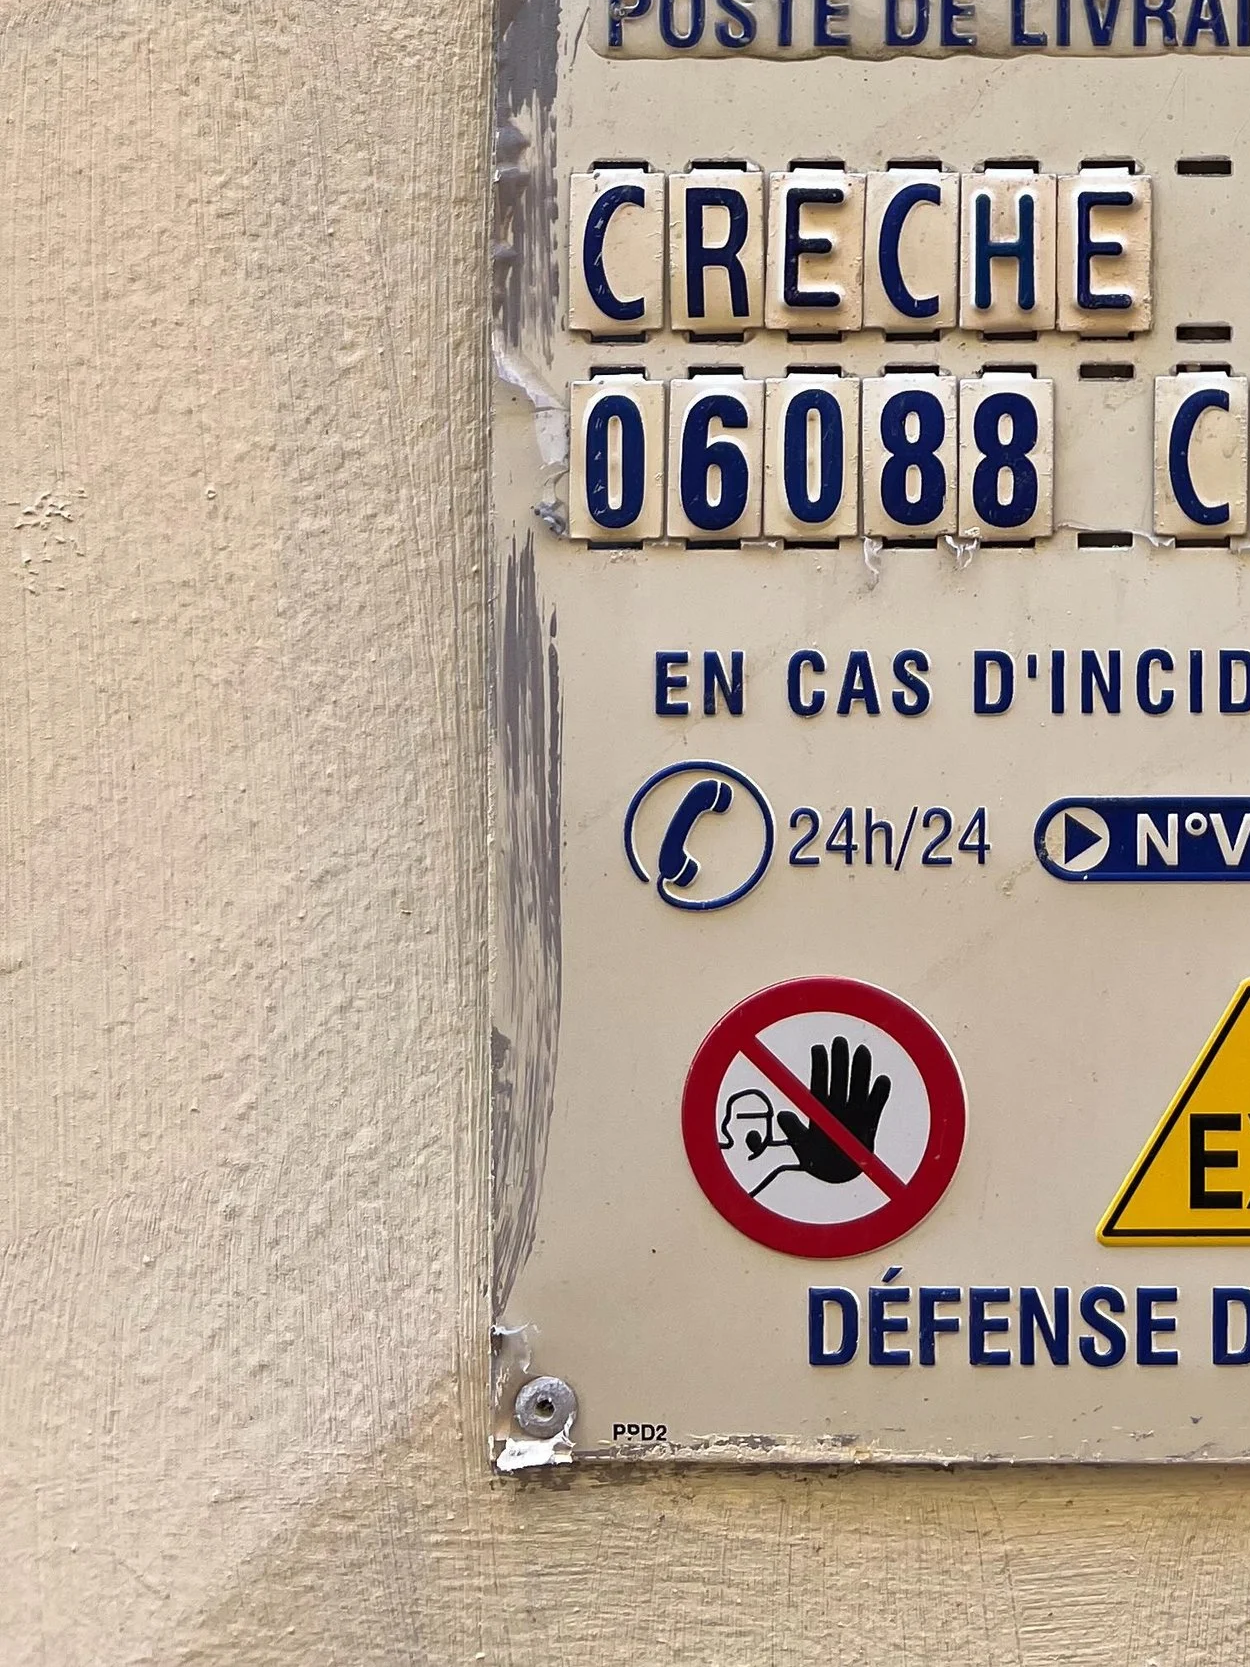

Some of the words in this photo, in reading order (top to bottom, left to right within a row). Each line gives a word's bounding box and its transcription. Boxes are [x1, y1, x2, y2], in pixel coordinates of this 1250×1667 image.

[582, 182, 1136, 321] CRECHE
[584, 387, 1040, 531] 06088
[654, 649, 746, 716] EN
[786, 647, 933, 717] CAS
[787, 806, 992, 872] 24h/24
[807, 1266, 1180, 1368] DÉFENSE
